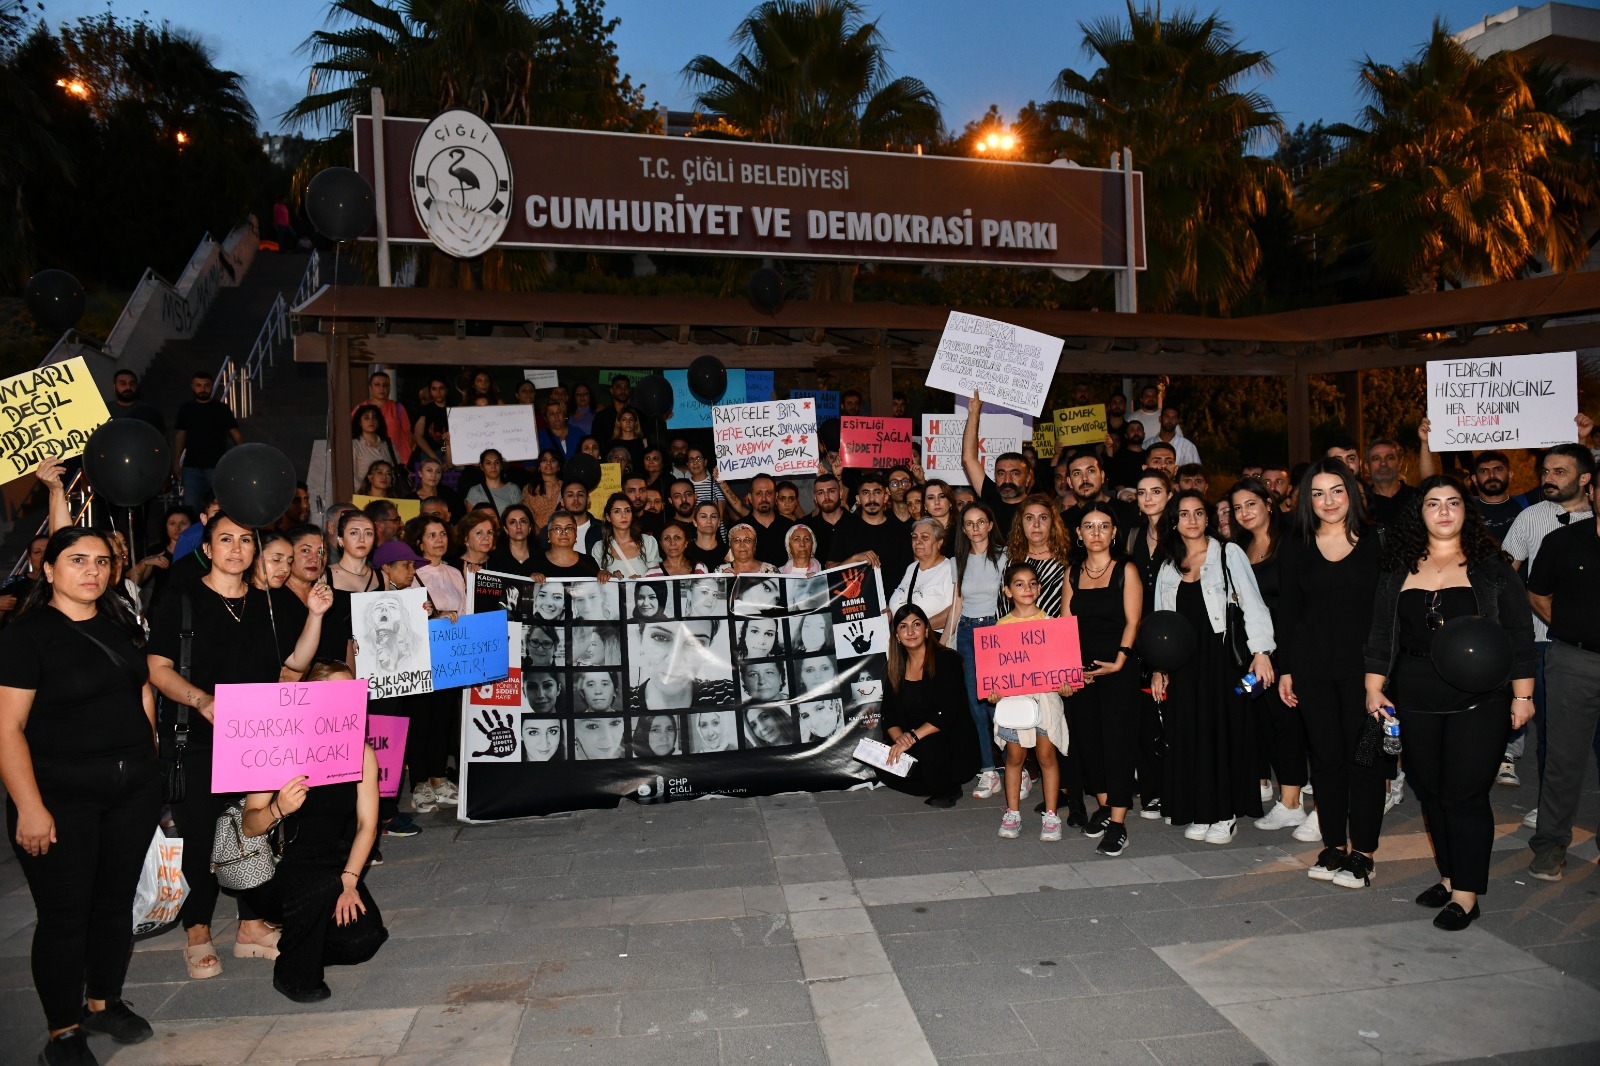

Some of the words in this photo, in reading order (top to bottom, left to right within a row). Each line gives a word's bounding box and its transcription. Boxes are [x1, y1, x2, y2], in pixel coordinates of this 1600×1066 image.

[435, 124, 488, 143] ÇİĞLİ
[639, 156, 675, 179] T.C.
[682, 155, 734, 186] ÇİĞLİ
[741, 163, 850, 190] BELEDİYESİ
[525, 193, 743, 236] CUMHURİYET
[752, 206, 792, 239] VE
[807, 208, 973, 247] DEMOKRASİ
[981, 219, 1058, 250] PARKI
[2, 391, 73, 427] DEĞİL
[713, 406, 770, 425] RASTGELE
[776, 402, 800, 421] BİR
[1060, 408, 1096, 422] ÖLMEK
[1446, 402, 1466, 415] HER
[1477, 400, 1520, 415] KADININ
[1457, 415, 1500, 427] HESABINI
[716, 427, 743, 443] YERE
[745, 425, 778, 438] ÇİÇEK
[876, 429, 911, 443] SAĞLA
[716, 445, 733, 459] BİR
[778, 446, 813, 460] DENK
[775, 459, 820, 473] GELECEK
[841, 597, 865, 607] KADINA
[431, 627, 471, 643] TANBUL
[998, 650, 1030, 667] DAHA
[279, 684, 311, 707] BİZ
[225, 718, 305, 738] SUSARSAK
[314, 713, 360, 736] ONLAR
[367, 736, 389, 751] ELİK
[241, 743, 350, 769] ÇOĞALACAK!
[668, 778, 688, 787] CHP
